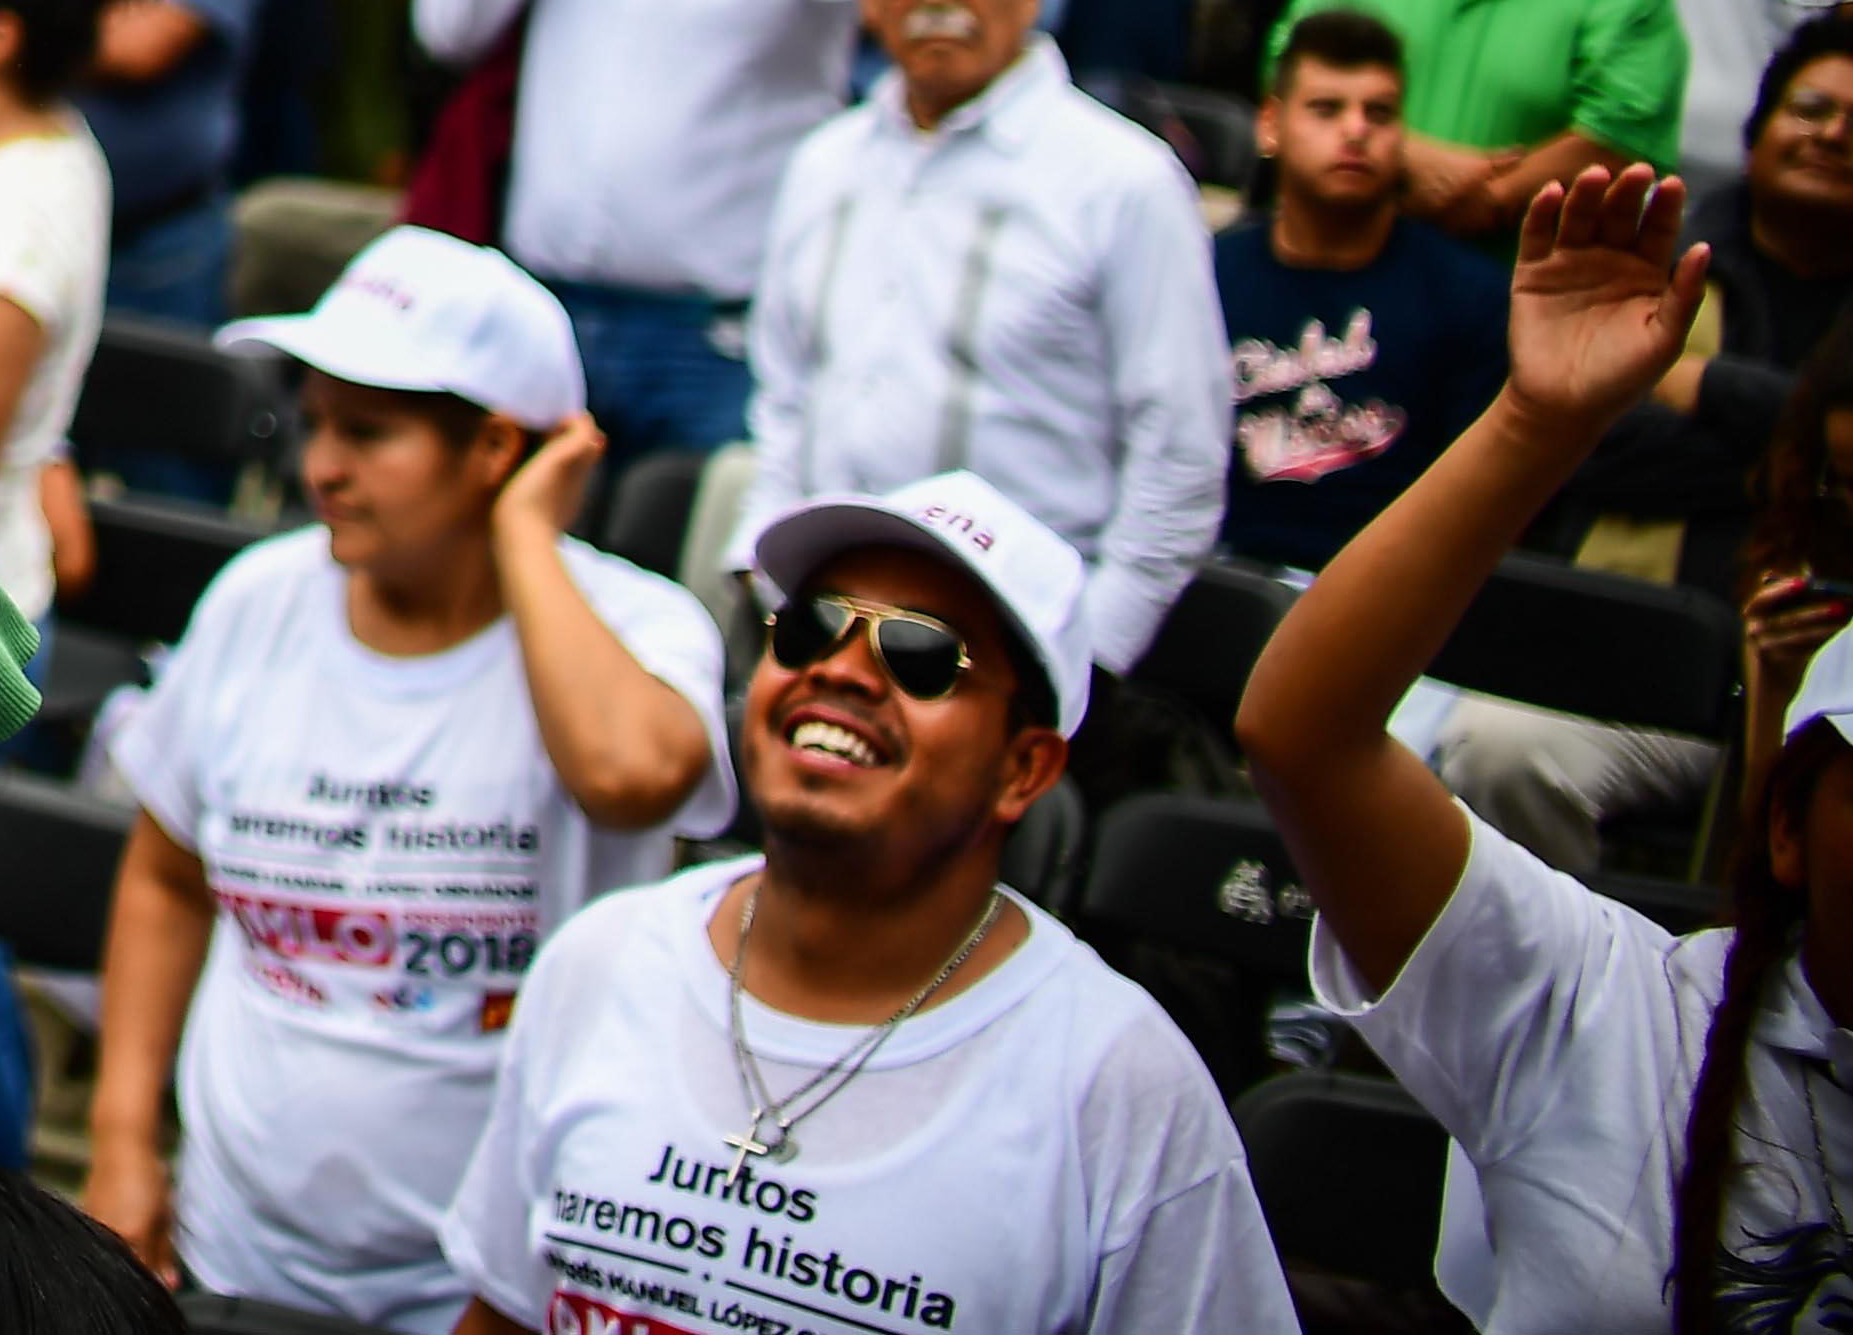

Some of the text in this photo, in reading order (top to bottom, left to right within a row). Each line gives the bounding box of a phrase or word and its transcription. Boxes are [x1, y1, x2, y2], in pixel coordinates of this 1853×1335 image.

[404, 930, 538, 975] 2018
[648, 1144, 819, 1224] Juntos
[740, 1224, 956, 1331] historia
